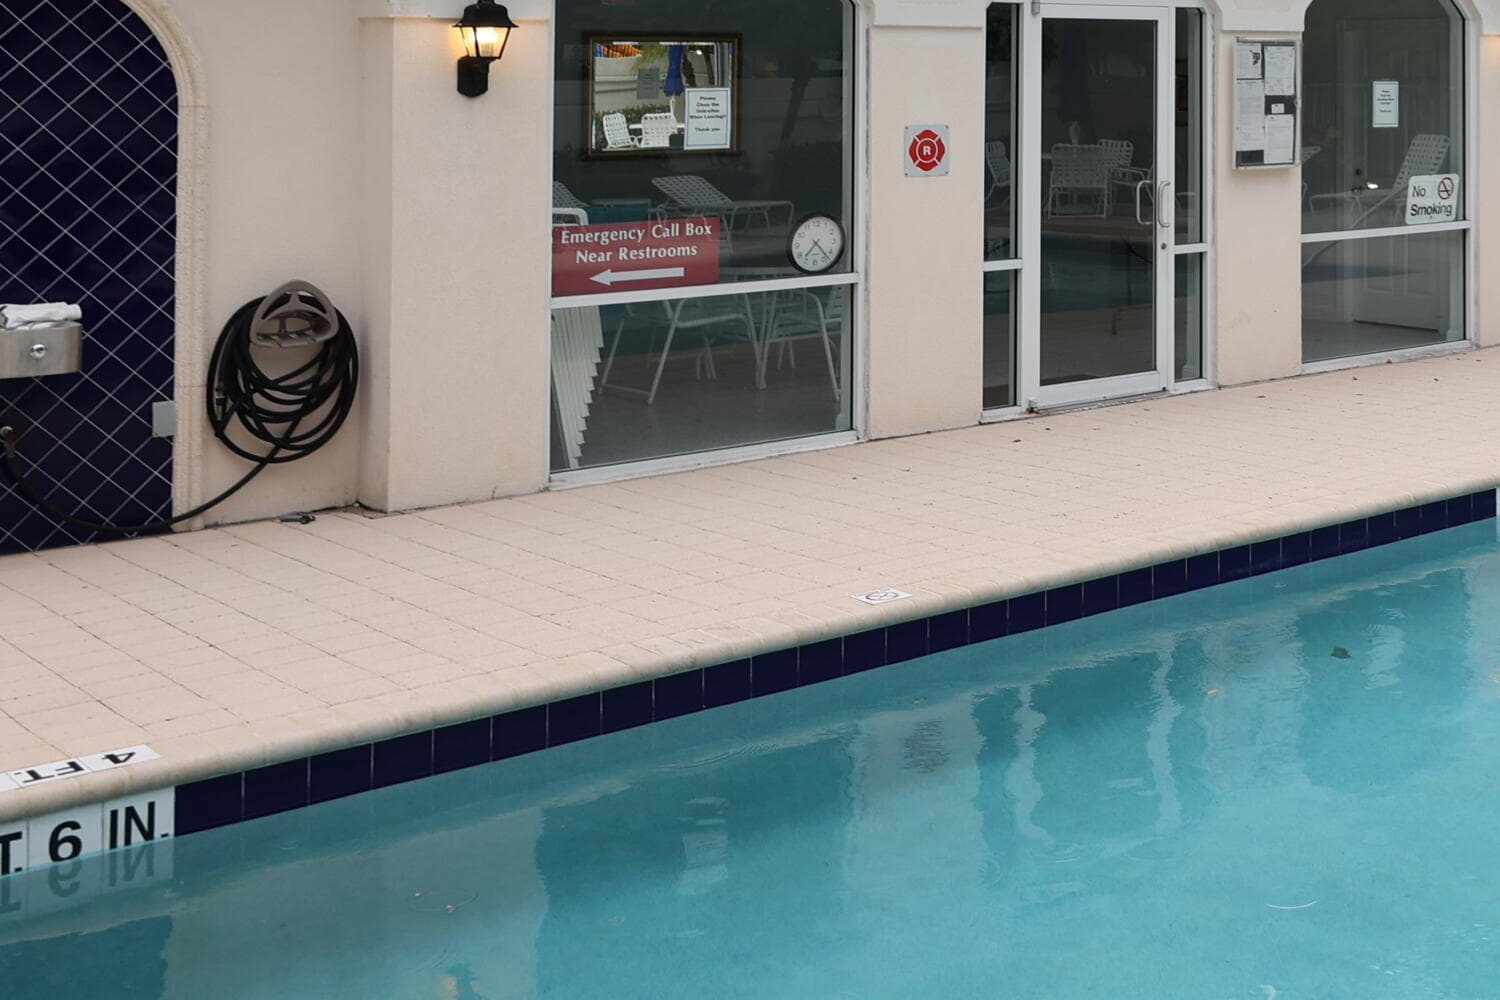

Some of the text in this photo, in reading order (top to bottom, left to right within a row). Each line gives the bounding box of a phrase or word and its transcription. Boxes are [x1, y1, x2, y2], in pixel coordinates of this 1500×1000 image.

[922, 145, 932, 156] R
[1412, 185, 1426, 198] No
[1410, 201, 1452, 217] Smoking
[812, 220, 821, 228] 12
[561, 222, 713, 246] Emergency Call Box
[575, 245, 697, 264] Near Restrooms
[14, 751, 136, 784] 4 FT.
[48, 820, 83, 863] 6
[109, 801, 169, 850] IN.
